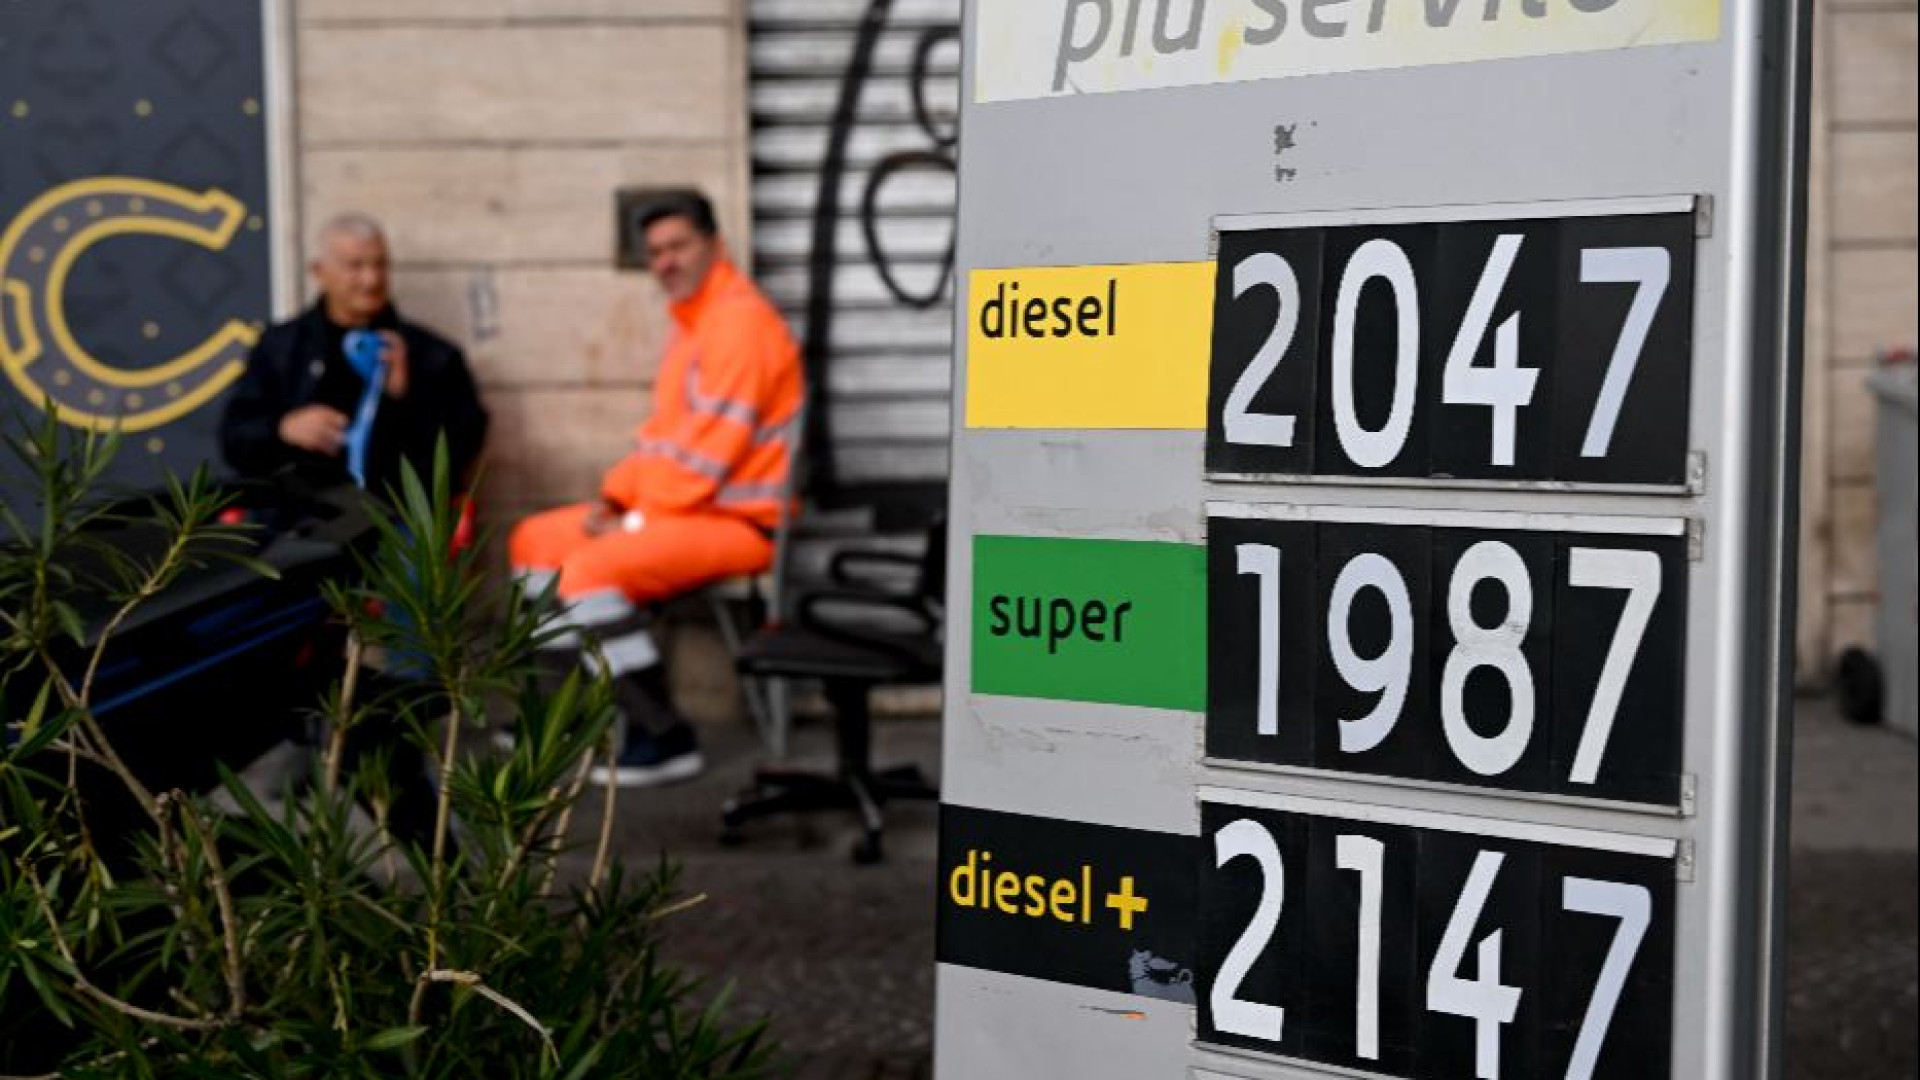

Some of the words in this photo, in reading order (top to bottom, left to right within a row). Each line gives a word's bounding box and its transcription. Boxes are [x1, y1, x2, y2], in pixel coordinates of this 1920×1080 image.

[980, 279, 1116, 338] diesel
[1223, 234, 1671, 468] 2047
[990, 594, 1132, 654] super
[1236, 540, 1663, 785] 1987
[1211, 819, 1651, 1080] 2147
